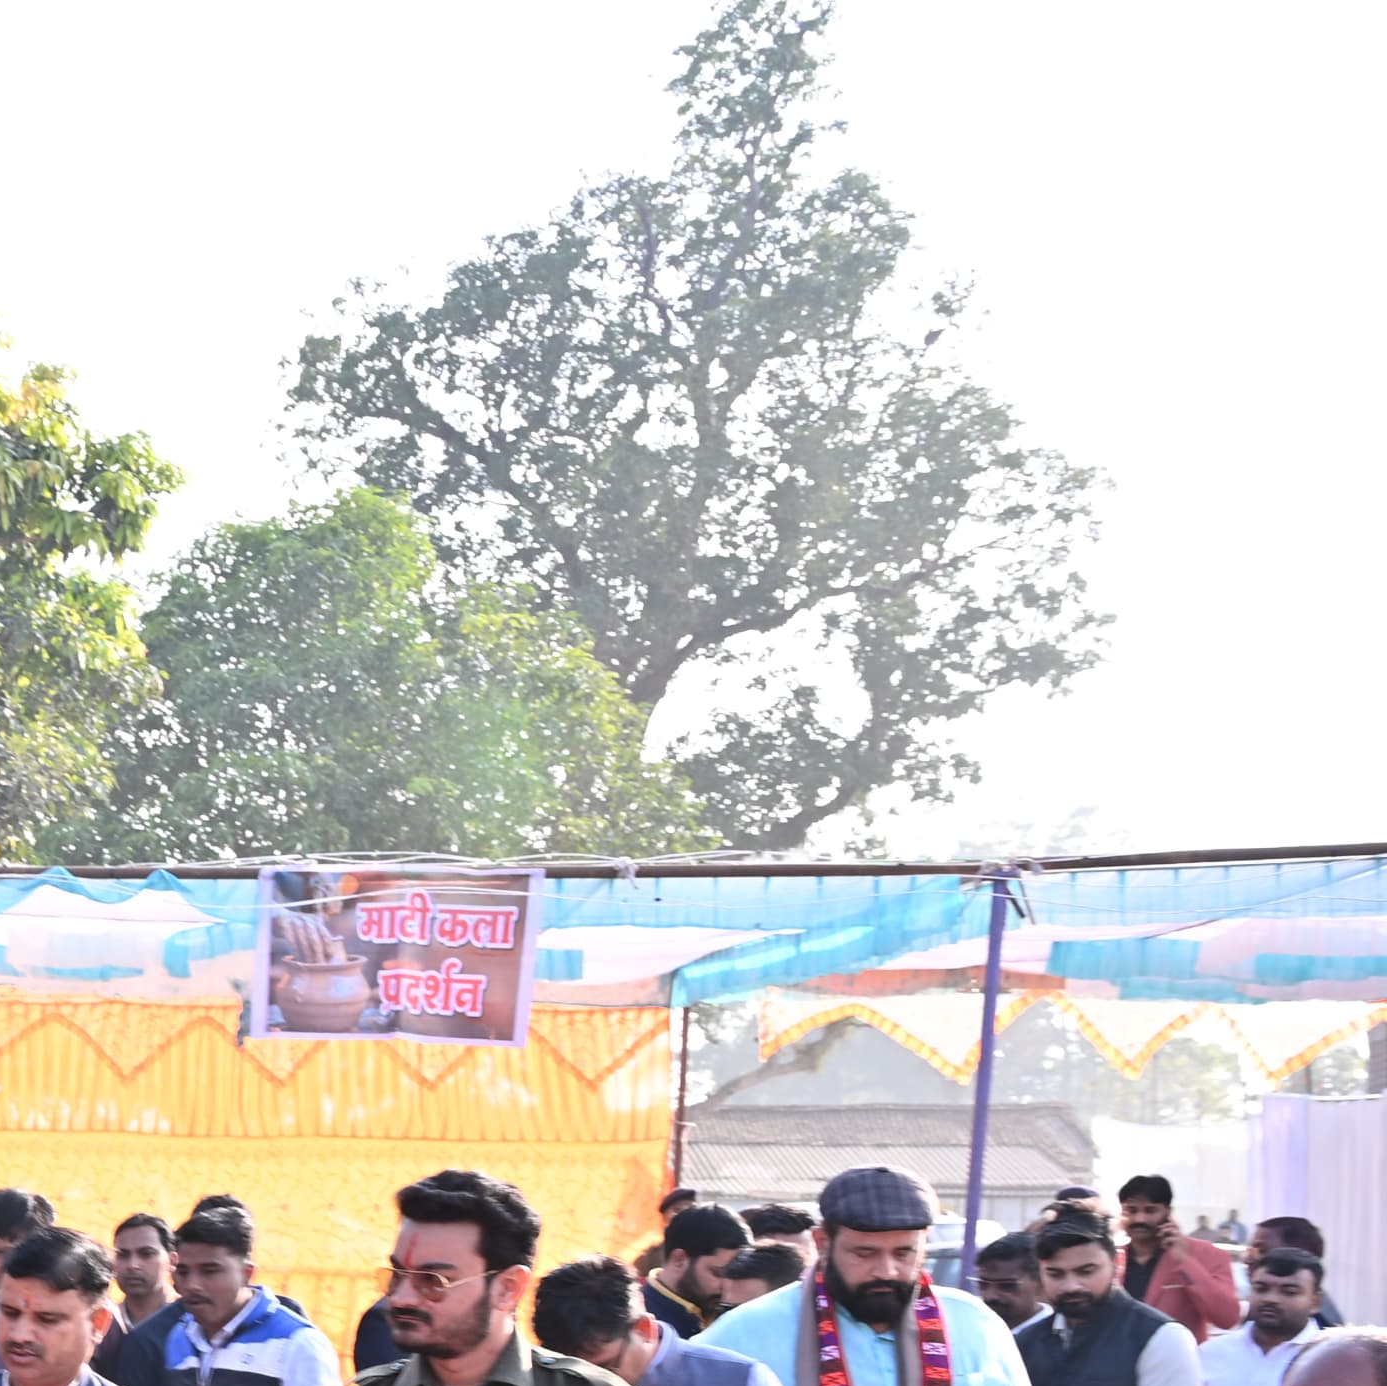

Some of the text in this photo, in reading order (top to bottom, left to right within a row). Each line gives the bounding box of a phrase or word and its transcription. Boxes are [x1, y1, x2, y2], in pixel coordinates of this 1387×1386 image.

[358, 892, 517, 945] माटी कला
[380, 962, 483, 1013] प्रदर्शन
